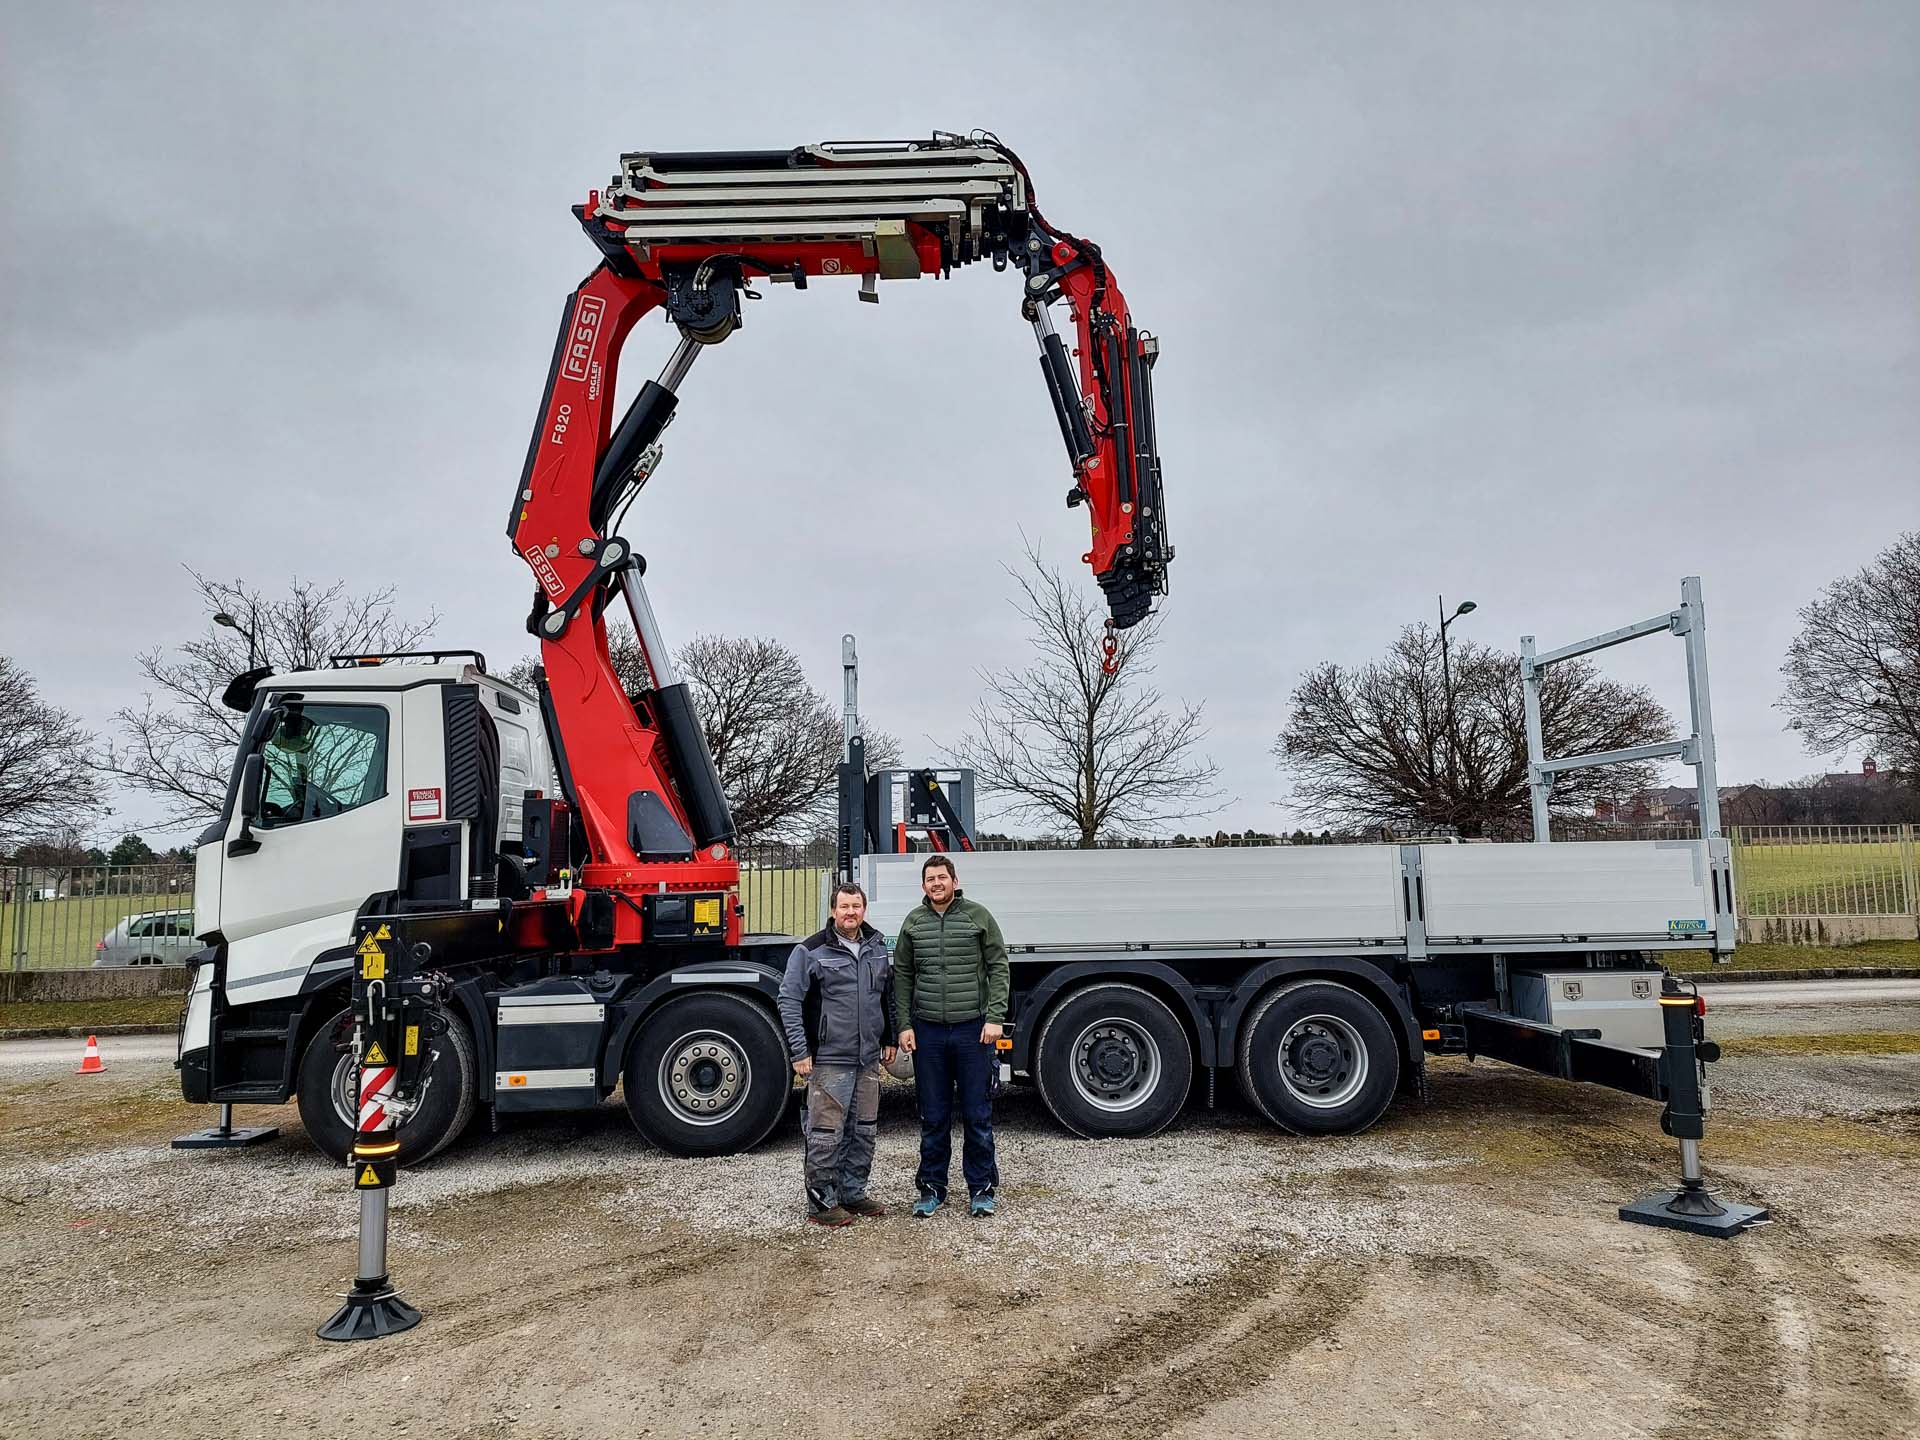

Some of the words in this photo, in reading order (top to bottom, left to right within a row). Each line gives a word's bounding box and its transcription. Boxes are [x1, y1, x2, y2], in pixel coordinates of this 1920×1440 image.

[568, 302, 600, 374] FASSI
[588, 360, 600, 401] KOGLER
[551, 404, 572, 445] F820
[529, 550, 561, 591] FASSI
